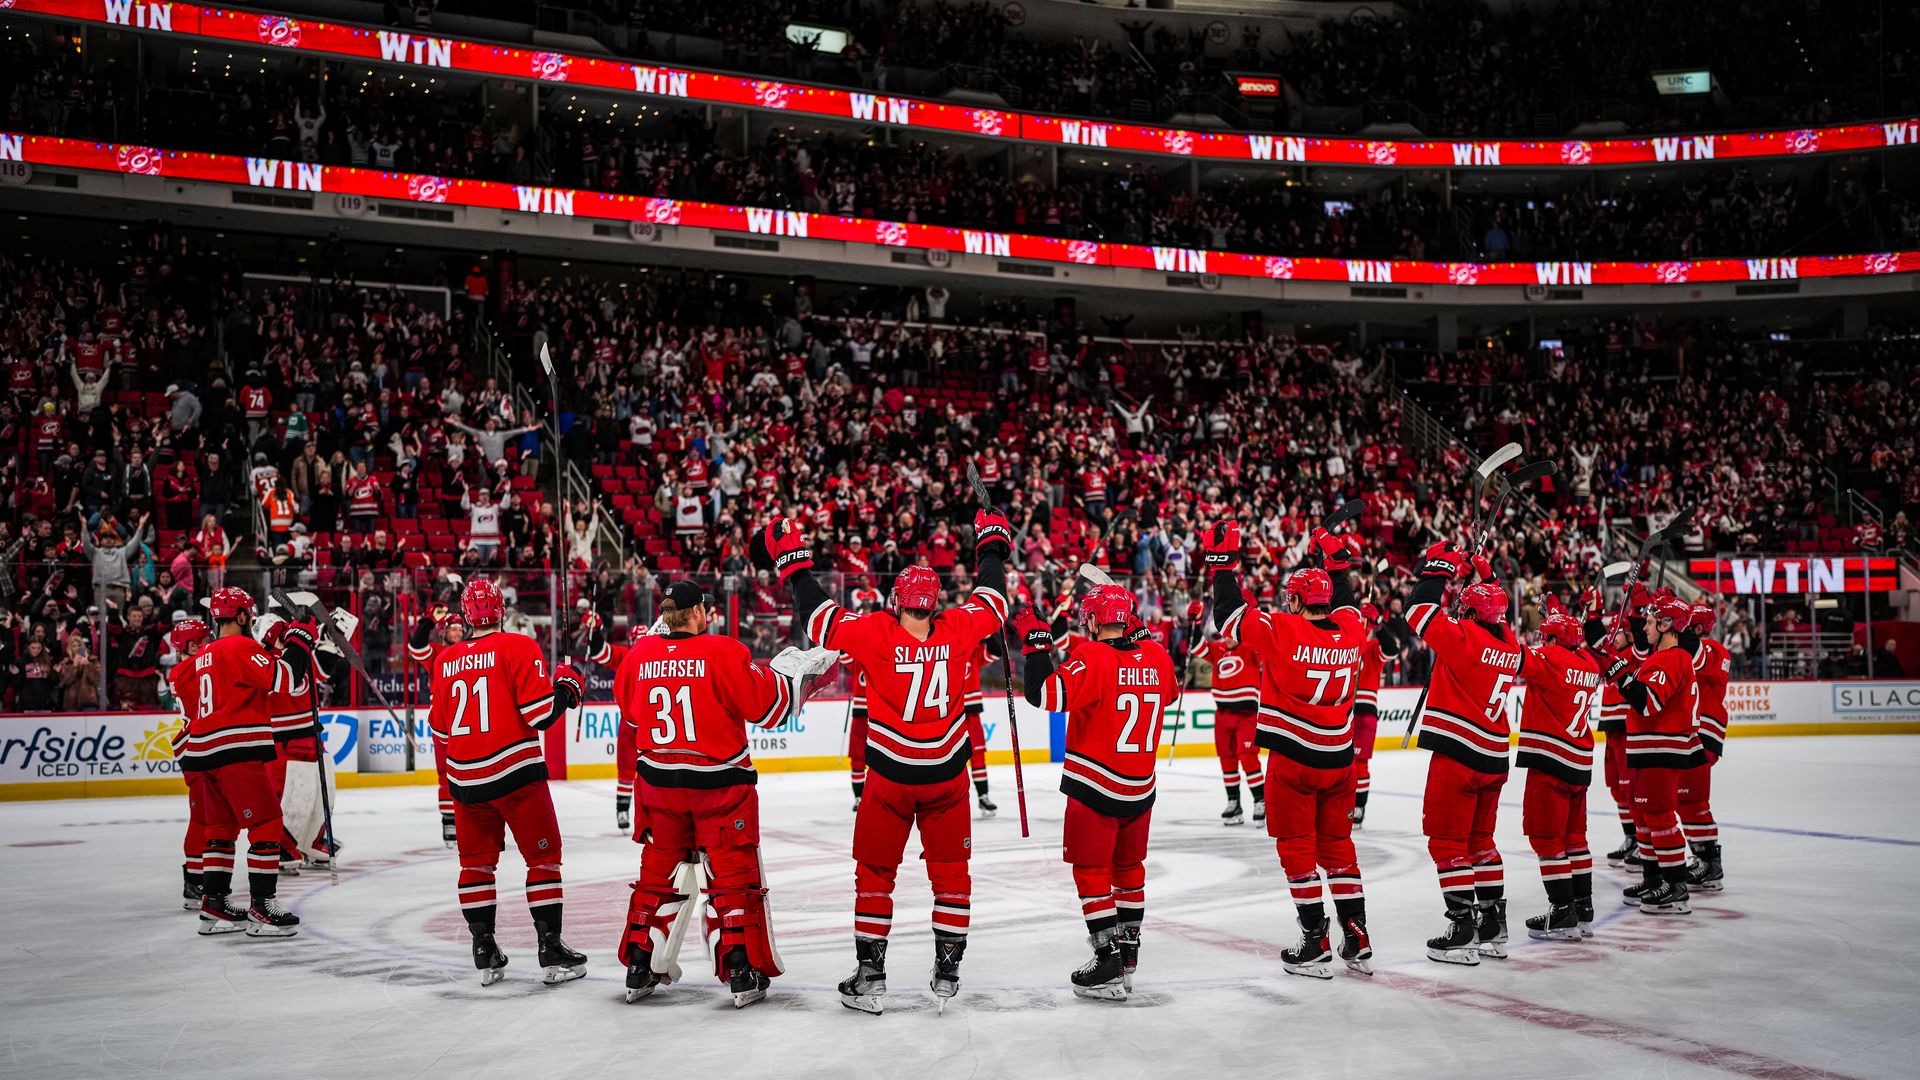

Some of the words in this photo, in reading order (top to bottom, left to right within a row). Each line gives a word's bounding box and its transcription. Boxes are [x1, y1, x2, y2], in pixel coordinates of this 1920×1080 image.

[104, 0, 172, 32] WIN
[379, 31, 453, 69] WIN
[630, 66, 688, 98] WIN
[1668, 75, 1693, 85] UNC
[850, 93, 909, 125] WIN
[1061, 121, 1109, 148] WIN
[1884, 123, 1919, 146] WI
[1250, 135, 1306, 162] WIN
[1453, 143, 1501, 166] WIN
[1654, 136, 1715, 162] WIN
[2, 163, 25, 176] 118
[248, 157, 324, 192] WIN
[341, 197, 362, 210] 119
[517, 186, 575, 216] WIN
[633, 223, 652, 236] 120
[745, 206, 810, 238] WIN
[963, 230, 1012, 258] WIN
[1153, 247, 1209, 274] WIN
[1347, 261, 1393, 283] WIN
[1747, 258, 1799, 281] WIN
[1536, 261, 1593, 285] WIN
[249, 394, 264, 409] 74
[1426, 559, 1455, 573] CCM
[1731, 557, 1845, 594] WIN
[919, 597, 928, 607] 74
[481, 617, 490, 625] 21
[1117, 611, 1125, 621] 27
[250, 653, 270, 668] 19
[443, 651, 496, 678] NIKISHIN
[894, 644, 950, 663] SLAVIN
[1481, 647, 1518, 670] CHATF
[638, 659, 706, 681] ANDERSEN
[1118, 667, 1160, 686] EHLERS
[1565, 668, 1599, 689] STANK
[1649, 670, 1667, 685] 20
[590, 677, 614, 690] Son
[895, 660, 950, 722] 74
[1304, 667, 1352, 707] 77
[1729, 685, 1770, 697] RGERY
[451, 675, 491, 738] 21
[1485, 673, 1514, 723] 5
[1690, 681, 1700, 727] 2
[1841, 688, 1920, 706] SILAC
[649, 685, 697, 745] 31
[1116, 693, 1161, 753] 27
[0, 725, 126, 769] rfside
[752, 738, 787, 750] TORS
[37, 764, 79, 777] ICED
[87, 762, 123, 775] TEA
[145, 760, 181, 773] VOD
